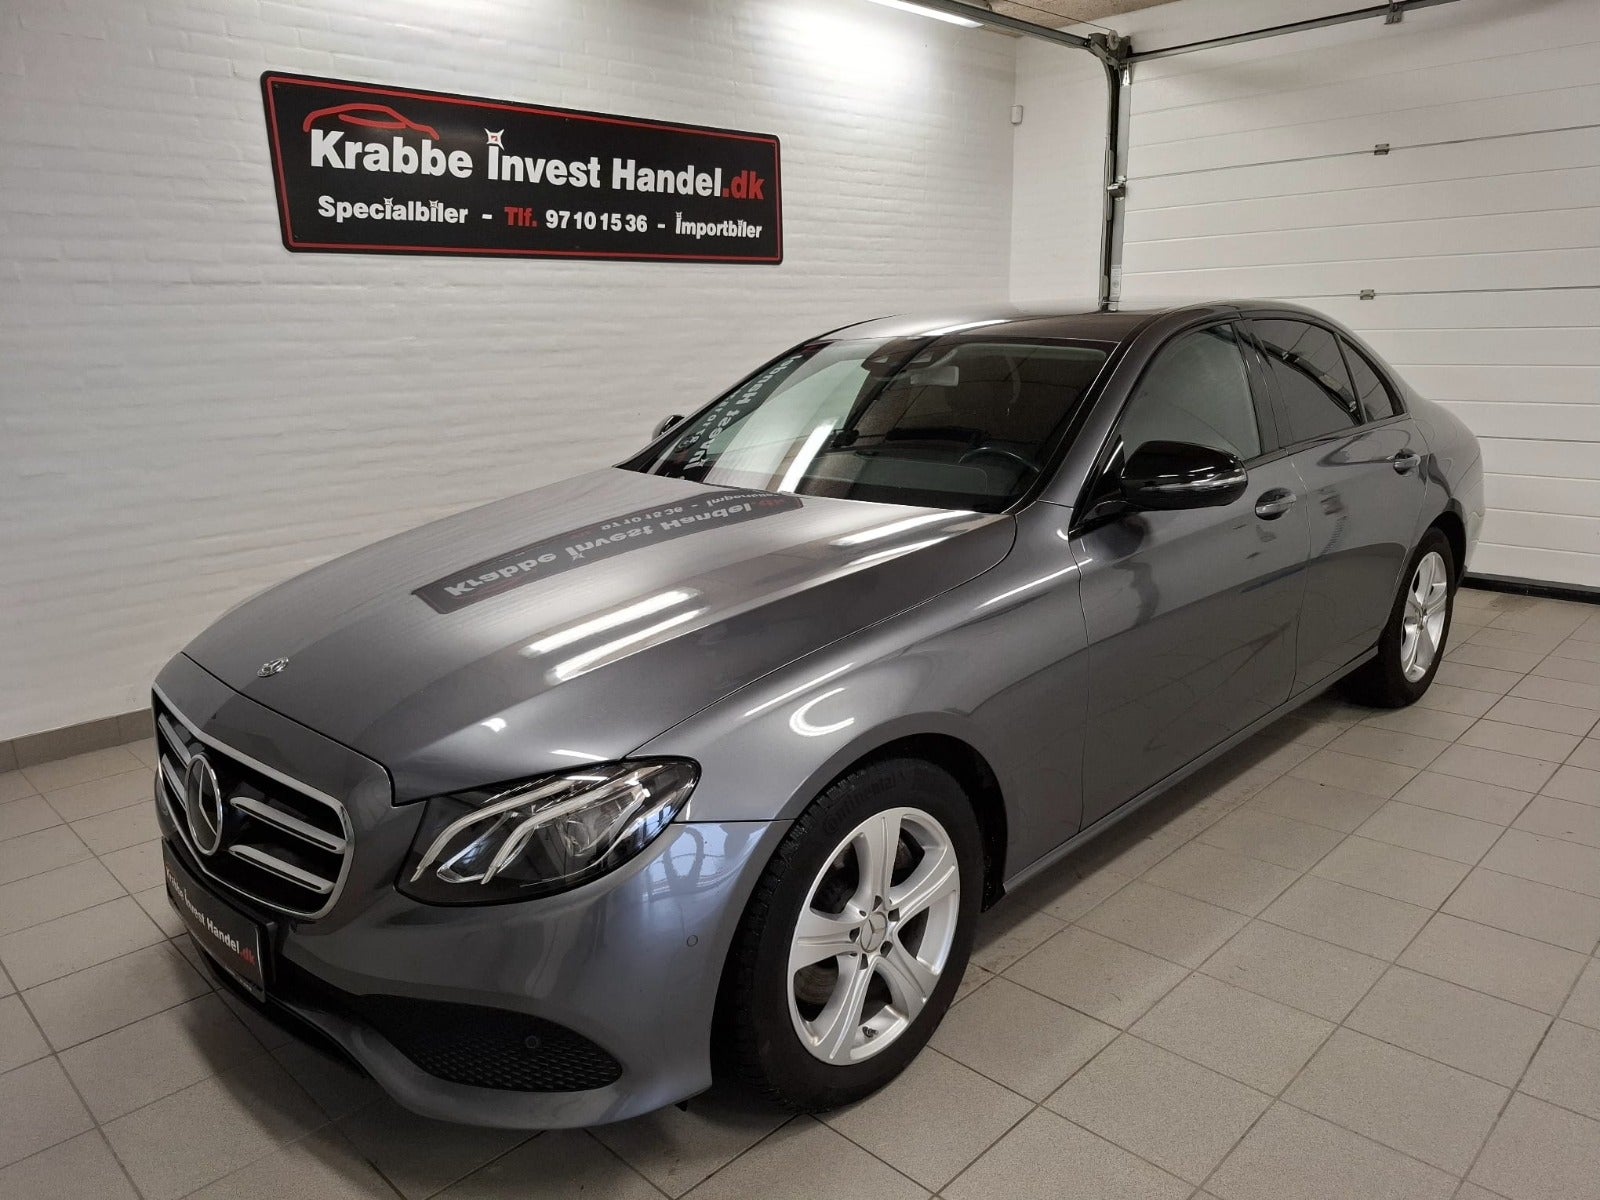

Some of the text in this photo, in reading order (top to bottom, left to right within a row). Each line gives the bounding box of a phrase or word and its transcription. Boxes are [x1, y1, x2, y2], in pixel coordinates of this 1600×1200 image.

[310, 128, 766, 200] Krabbe Invest Handel.dk
[317, 195, 469, 224] Specialbiler
[504, 205, 538, 228] Tlf.
[675, 211, 763, 240] Importbiler
